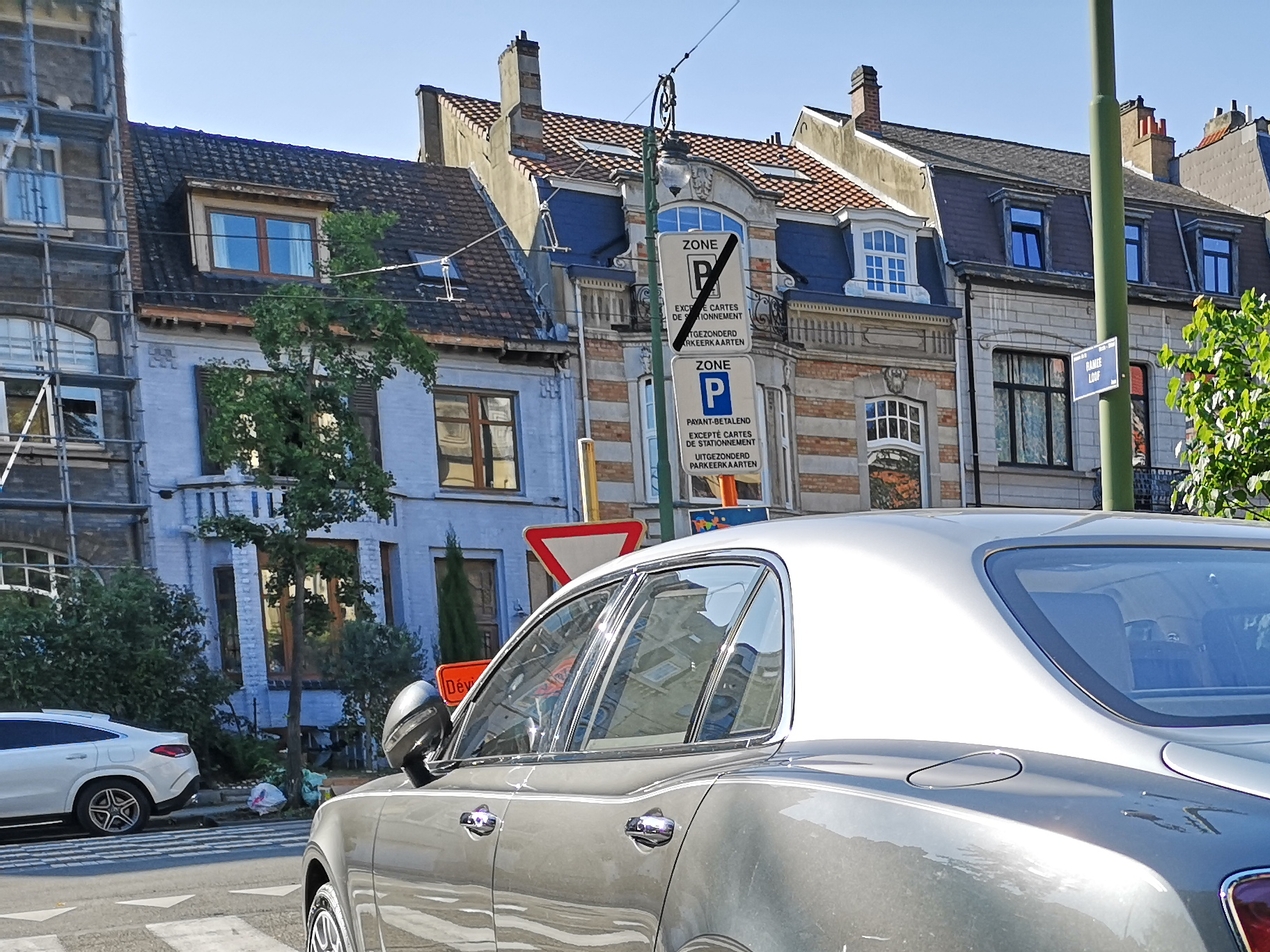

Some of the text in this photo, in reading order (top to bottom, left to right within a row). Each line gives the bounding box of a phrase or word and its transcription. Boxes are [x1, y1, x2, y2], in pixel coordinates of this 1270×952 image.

[682, 240, 718, 250] ZONE
[709, 303, 739, 312] CARTES
[672, 313, 682, 321] DE
[696, 360, 731, 371] ZONE
[705, 378, 725, 409] P
[686, 417, 751, 426] PAYANT-BETALEND
[688, 429, 753, 439] EXCEPTÉ CARTES
[686, 438, 756, 448] DE STATIONNEMENT
[694, 452, 750, 461] UITGEZONDERD
[689, 460, 758, 469] PARKEERKAARTEN
